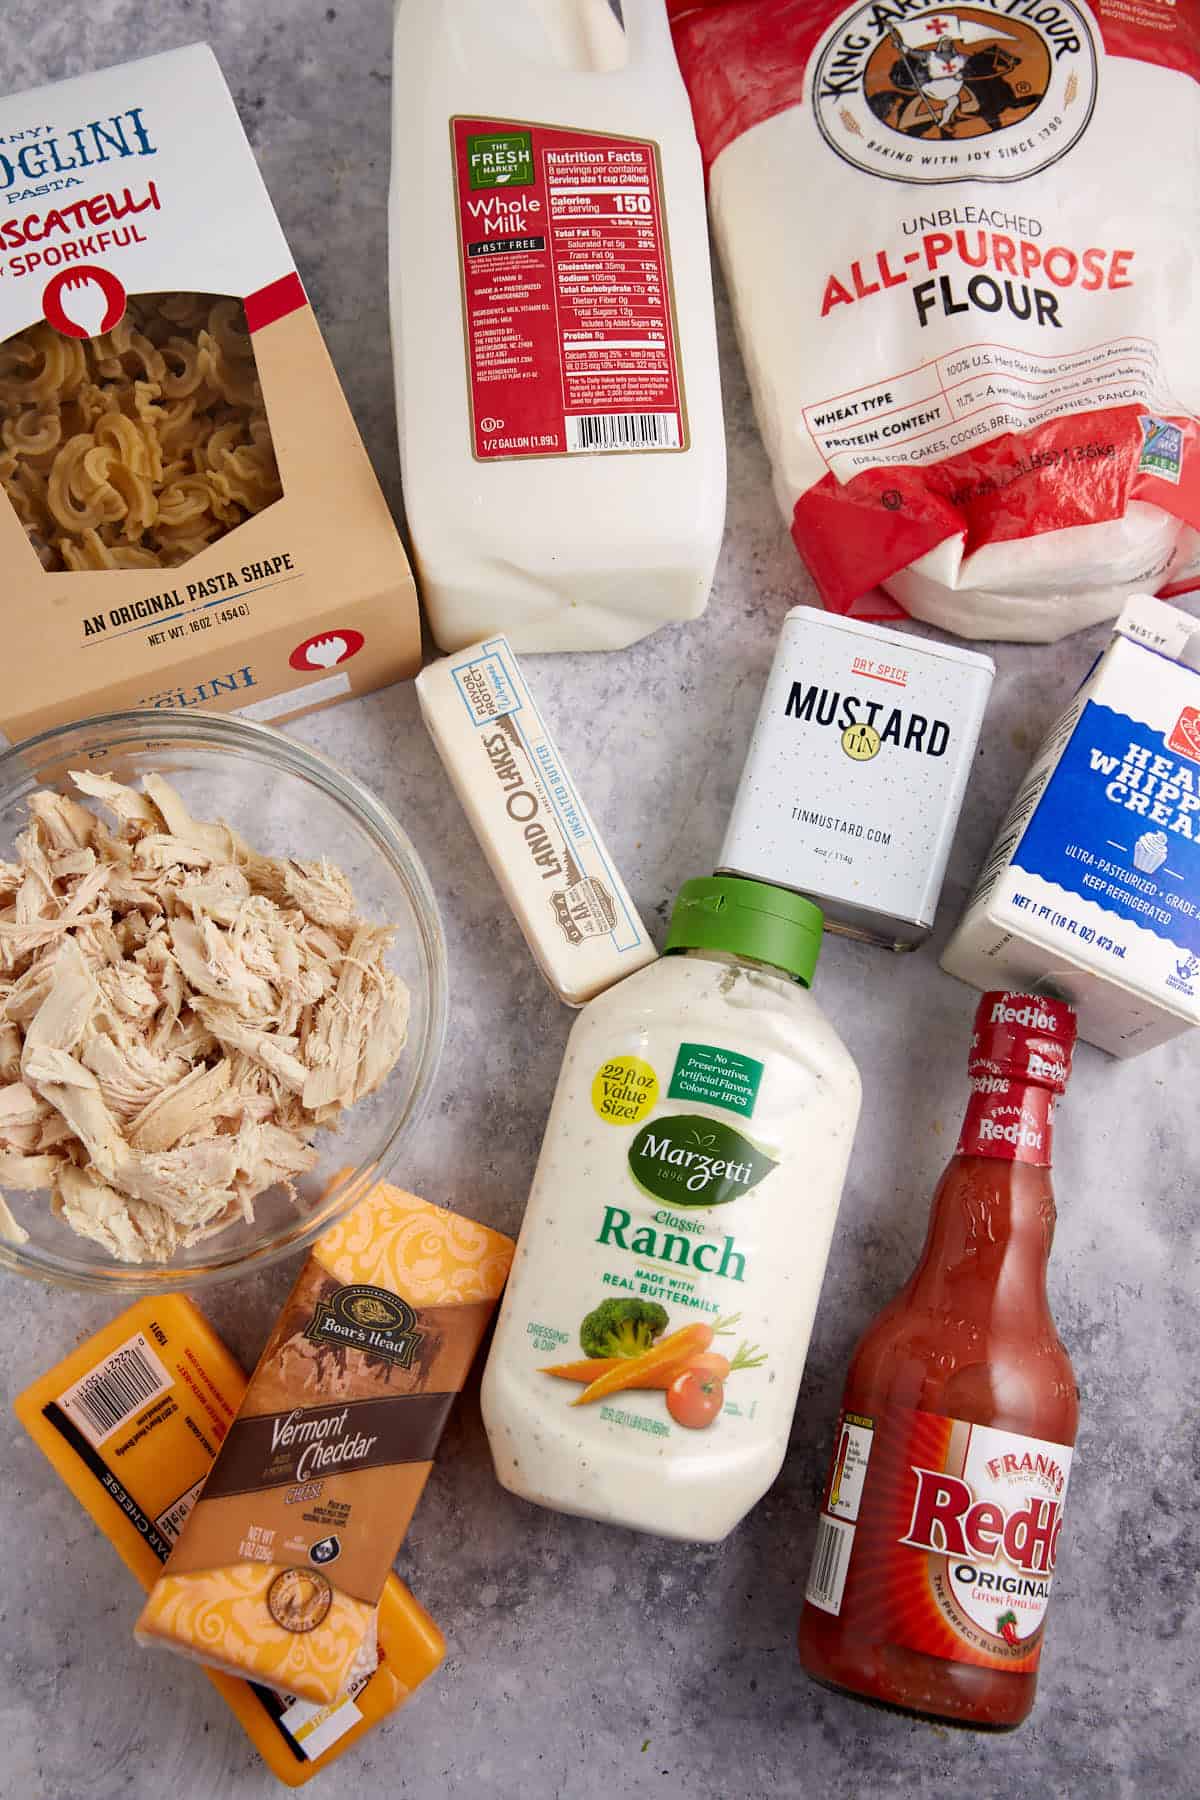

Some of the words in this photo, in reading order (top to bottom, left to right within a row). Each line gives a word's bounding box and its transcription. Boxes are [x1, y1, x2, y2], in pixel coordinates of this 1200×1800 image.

[820, 33, 871, 103] KING
[471, 150, 530, 167] FRESH
[547, 152, 604, 163] Nutrition
[607, 151, 643, 162] Facts
[866, 140, 913, 163] BAKING
[920, 155, 959, 165] WITH
[967, 151, 991, 162] JOY
[998, 138, 1035, 159] SINCE
[483, 164, 519, 174] MARKET
[549, 175, 579, 185] Serving
[581, 175, 596, 183] size
[603, 175, 618, 184] cup
[556, 166, 592, 175] servings
[593, 166, 606, 175] per
[608, 165, 648, 173] container
[6, 176, 84, 204] PASTA
[551, 196, 591, 205] Calories
[613, 195, 652, 212] 150
[467, 194, 541, 217] Whole
[552, 206, 566, 215] per
[568, 204, 600, 215] serving
[484, 214, 528, 235] Milk
[902, 206, 1042, 238] UNBLEACHED
[9, 224, 147, 277] SPORKFUL
[509, 239, 537, 250] FREE
[567, 240, 601, 248] Saturated
[569, 251, 588, 259] Trans
[558, 263, 603, 271] Cholesterol
[640, 262, 658, 270] 12%
[559, 274, 589, 282] Sodium
[591, 273, 616, 282] 105mg
[820, 229, 1136, 318] ALL-PURPOSE
[559, 285, 579, 294] Total
[580, 284, 631, 294] Carbohydrate
[572, 296, 597, 306] Dietary
[599, 295, 617, 304] Fiber
[912, 274, 1063, 329] FLOUR
[574, 307, 591, 316] Total
[592, 307, 617, 317] Sugars
[620, 307, 633, 317] 12g
[613, 318, 630, 327] Added
[563, 332, 592, 340] Protein
[947, 359, 970, 377] 100%
[972, 354, 993, 368] U.S.
[986, 385, 995, 396] A
[814, 404, 859, 428] WHEAT
[861, 392, 894, 412] TYPE
[825, 431, 880, 449] PROTEIN
[882, 408, 942, 438] CONTENT
[910, 440, 949, 461] CAKES,
[950, 421, 990, 447] COOKIES,
[1028, 397, 1097, 424] BROWNIES,
[483, 438, 497, 450] 1/2
[498, 436, 529, 449] GALLON
[1063, 441, 1116, 464] 1.36kg
[83, 615, 107, 637] AN
[110, 589, 185, 629] ORIGINAL
[186, 571, 239, 602] PASTA
[241, 553, 294, 584] SHAPE
[147, 631, 167, 648] NET
[169, 625, 189, 640] WT.
[853, 656, 875, 673] DRY
[878, 662, 909, 682] SPICE
[463, 674, 485, 717] FLAVOR
[784, 681, 951, 757] MUSTARD
[847, 728, 878, 755] TIN
[481, 731, 525, 792] LAKES
[535, 744, 561, 786] BUTTER
[1123, 742, 1200, 796] HEA
[506, 790, 539, 822] O
[554, 785, 586, 840] UNSALTED
[1105, 782, 1200, 844] CREA
[791, 807, 892, 846] TINMUSTARD.COM
[523, 822, 562, 880] LAND
[1065, 844, 1158, 896] ULTRA-PASTEURIZED
[1166, 893, 1197, 917] GRADE
[1082, 872, 1107, 892] KEEP
[1105, 885, 1172, 925] REFRIGERATED
[1012, 893, 1032, 910] NET
[1031, 903, 1037, 914] 1
[1038, 905, 1052, 920] PT
[1067, 920, 1078, 934] FL
[1080, 926, 1096, 944] OZ)
[1096, 935, 1113, 951] 473
[990, 1003, 1057, 1031] RedHot
[714, 1054, 727, 1064] No
[601, 1064, 622, 1081] 22
[620, 1069, 636, 1086] fl
[637, 1075, 655, 1089] oz
[678, 1068, 720, 1086] Artificial
[603, 1081, 648, 1105] Value
[680, 1081, 708, 1095] Colors
[710, 1090, 720, 1098] or
[721, 1091, 748, 1106] HFCS
[600, 1099, 640, 1120] Size!
[978, 1118, 1043, 1150] RedHot
[639, 1134, 753, 1191] Marzetti
[655, 1207, 705, 1234] Classic
[594, 1204, 748, 1283] Ranch
[603, 1272, 634, 1291] REAL
[640, 1283, 720, 1313] BUTTERMILK
[634, 1269, 664, 1285] MADE
[668, 1278, 694, 1292] WITH
[149, 1322, 168, 1346] 15011
[320, 1316, 367, 1342] Boar's
[369, 1331, 406, 1353] Head
[526, 1321, 570, 1344] DRESSING
[540, 1339, 556, 1352] DIP
[271, 1407, 350, 1454] Vermont
[296, 1434, 378, 1482] Cheddar
[987, 1452, 1064, 1495] FRANK'S
[101, 1472, 150, 1533] CHEESE
[955, 1564, 1048, 1598] ORIGINAL
[934, 1575, 945, 1597] THE
[942, 1600, 978, 1641] PERFECT
[980, 1640, 1009, 1657] BLEND
